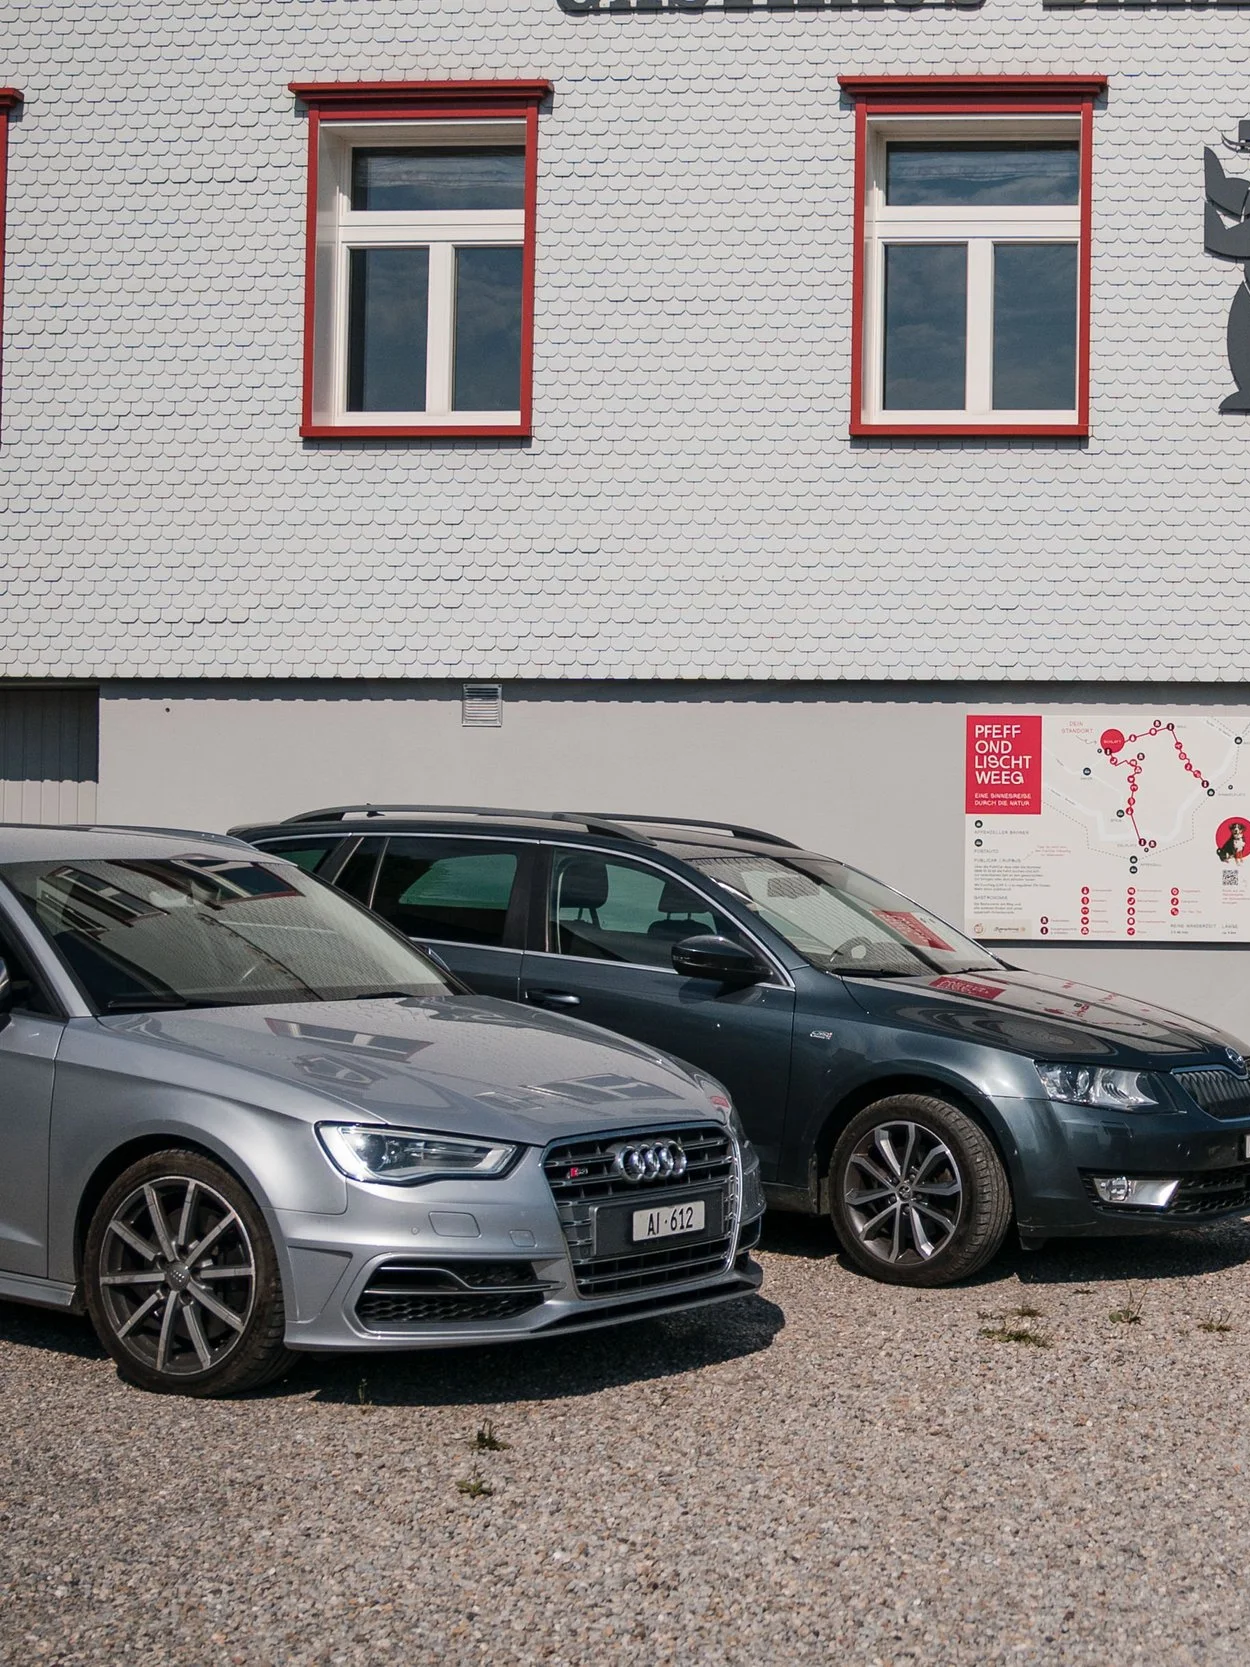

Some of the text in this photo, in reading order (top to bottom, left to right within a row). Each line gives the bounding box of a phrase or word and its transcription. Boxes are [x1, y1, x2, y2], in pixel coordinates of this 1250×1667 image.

[975, 724, 1021, 738] PFEFF
[975, 740, 1012, 754] OND
[974, 755, 1032, 769] LISCHT
[975, 770, 1024, 784] WEEG
